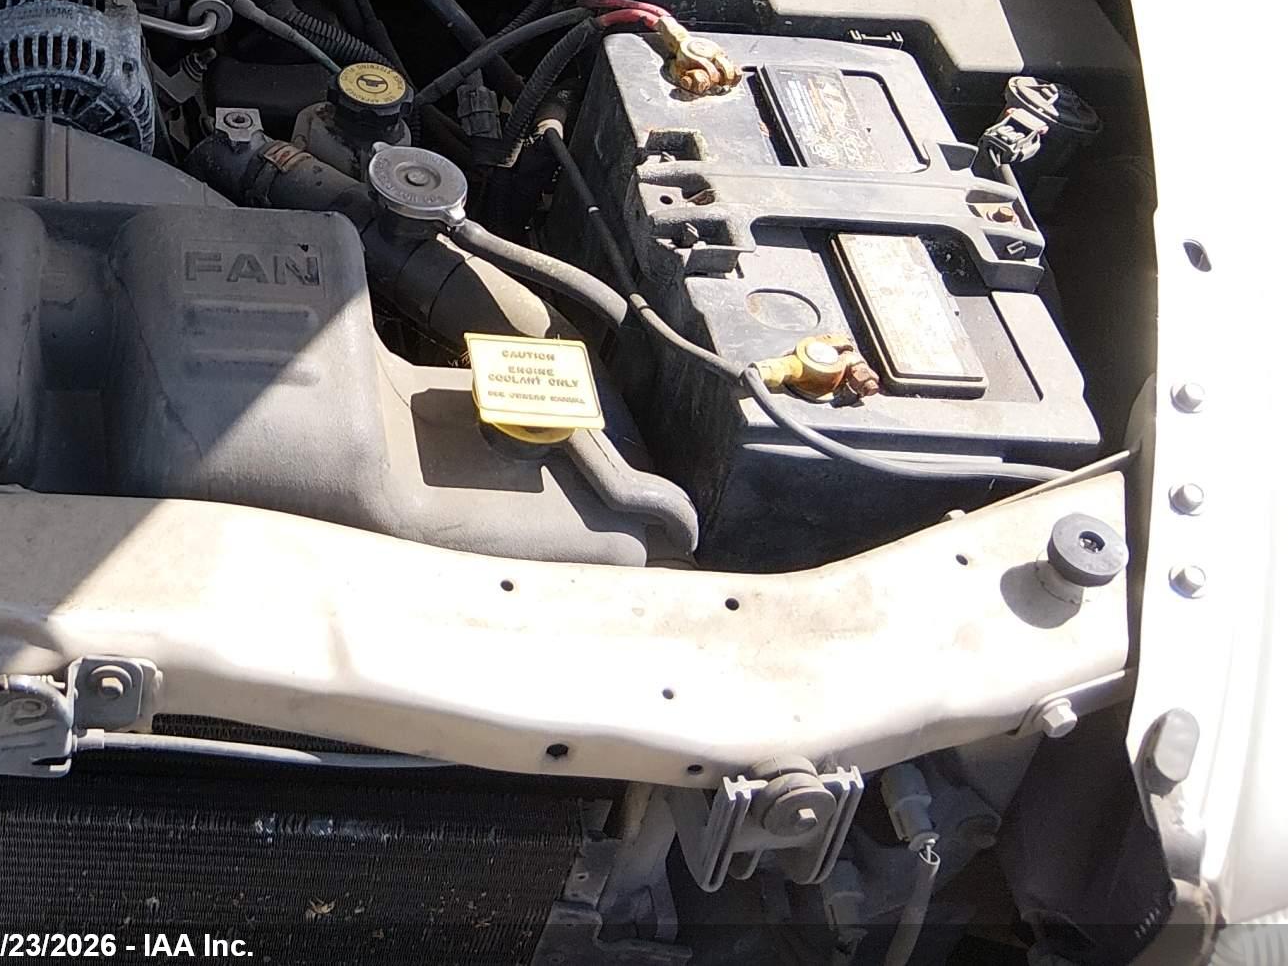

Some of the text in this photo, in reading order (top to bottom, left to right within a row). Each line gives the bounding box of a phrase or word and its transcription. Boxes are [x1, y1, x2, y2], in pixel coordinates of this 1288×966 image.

[181, 249, 323, 286] FAN
[501, 349, 556, 361] CAUTION
[507, 365, 555, 376] ENGINE
[488, 373, 580, 388] COOLANT ONLY
